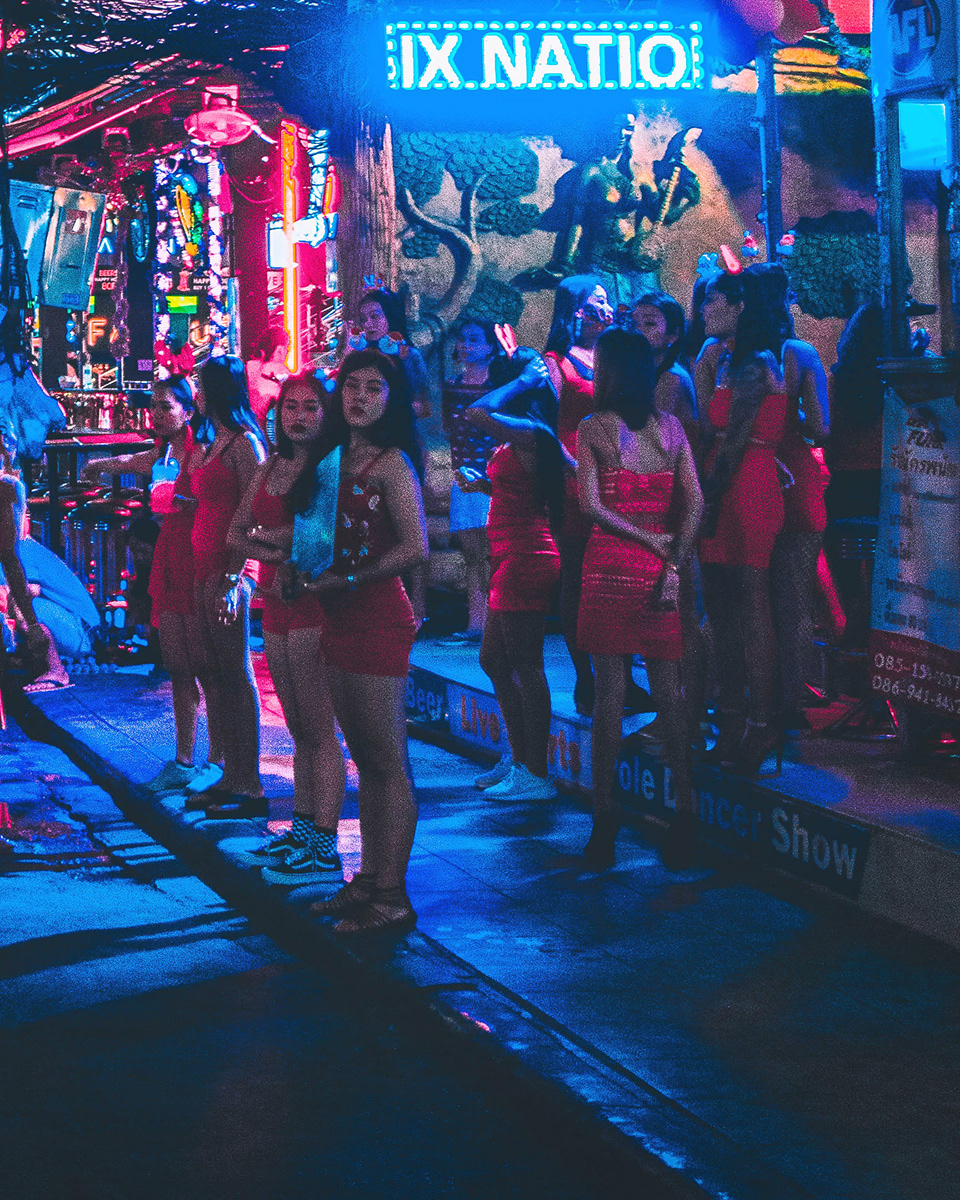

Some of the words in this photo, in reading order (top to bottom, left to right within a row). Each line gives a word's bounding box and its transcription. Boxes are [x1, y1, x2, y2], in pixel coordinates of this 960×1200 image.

[403, 34, 462, 89] IX
[483, 33, 695, 89] NATIO
[405, 677, 444, 722] Beer
[613, 754, 656, 802] ole
[770, 805, 859, 882] Show
